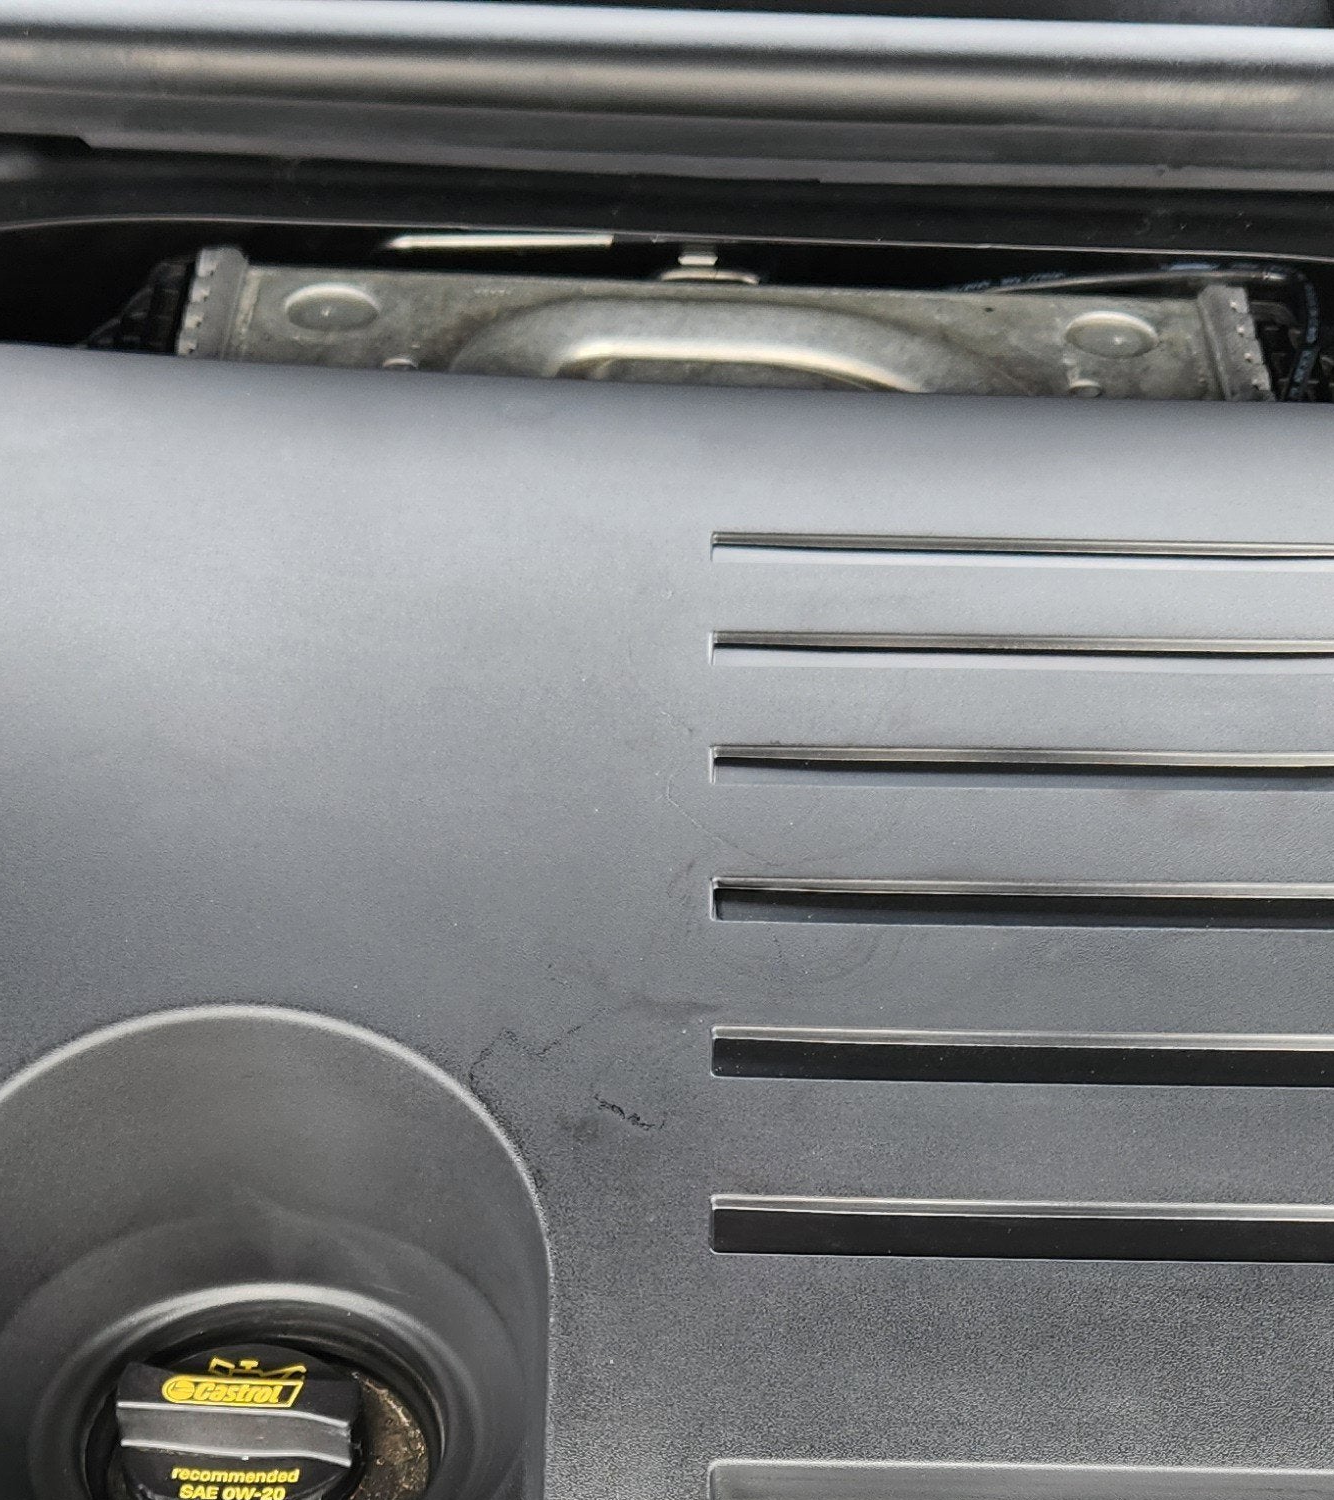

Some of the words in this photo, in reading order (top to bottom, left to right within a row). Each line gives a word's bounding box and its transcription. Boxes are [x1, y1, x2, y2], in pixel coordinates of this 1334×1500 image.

[193, 1382, 283, 1404] Castrol
[171, 1467, 300, 1483] recommended
[179, 1484, 219, 1500] SAE
